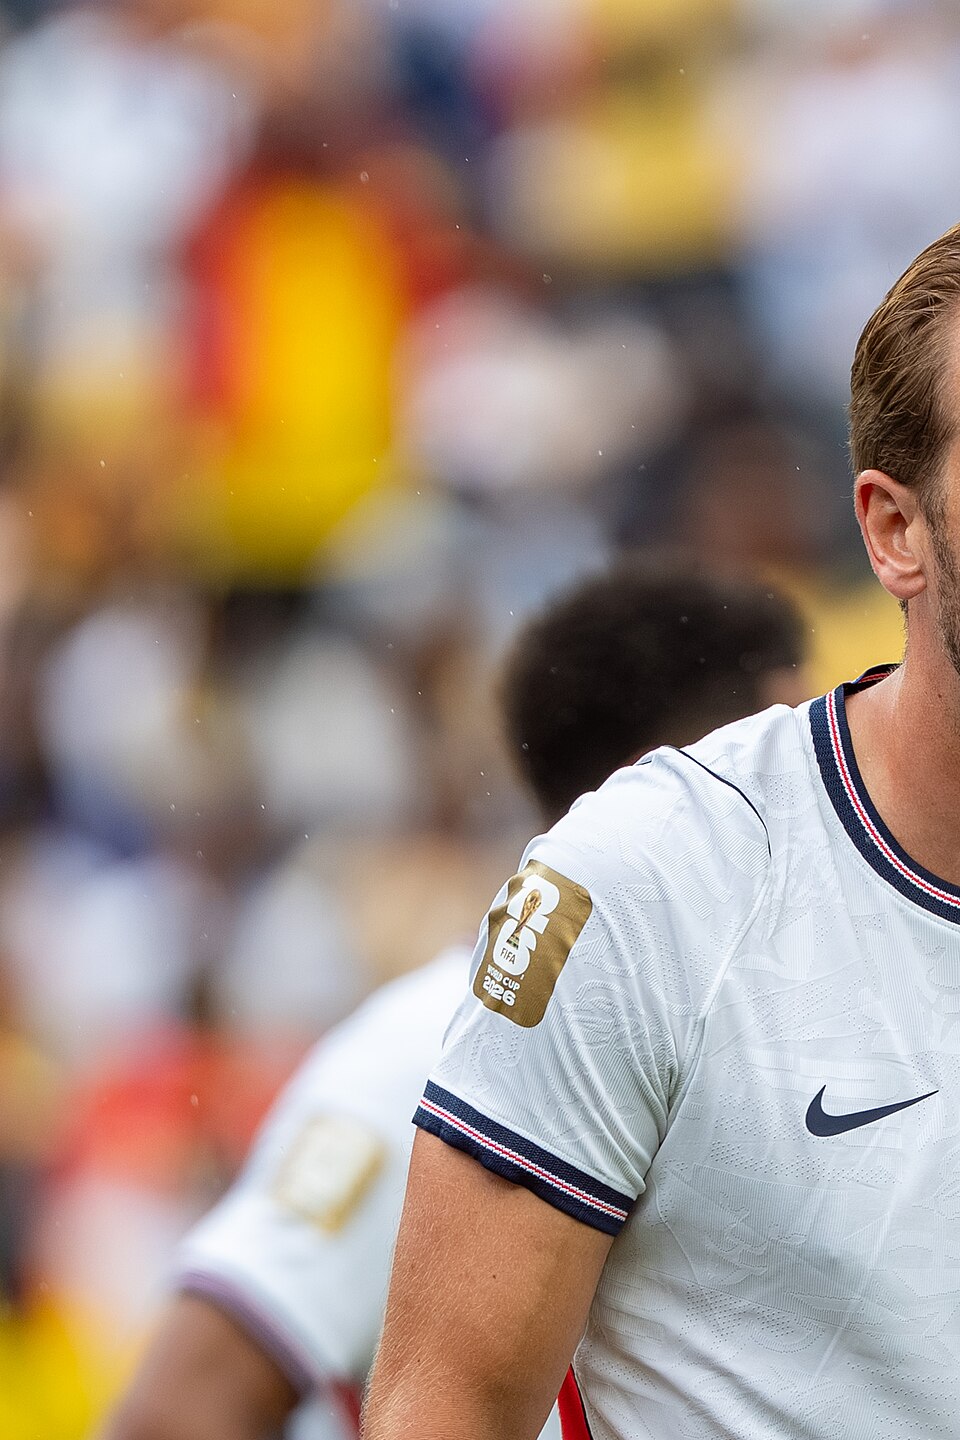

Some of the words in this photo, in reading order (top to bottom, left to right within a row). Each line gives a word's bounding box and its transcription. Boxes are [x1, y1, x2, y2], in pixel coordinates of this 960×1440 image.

[499, 947, 516, 965] FIFA
[482, 975, 517, 1006] 2026
[503, 976, 521, 991] CUP
